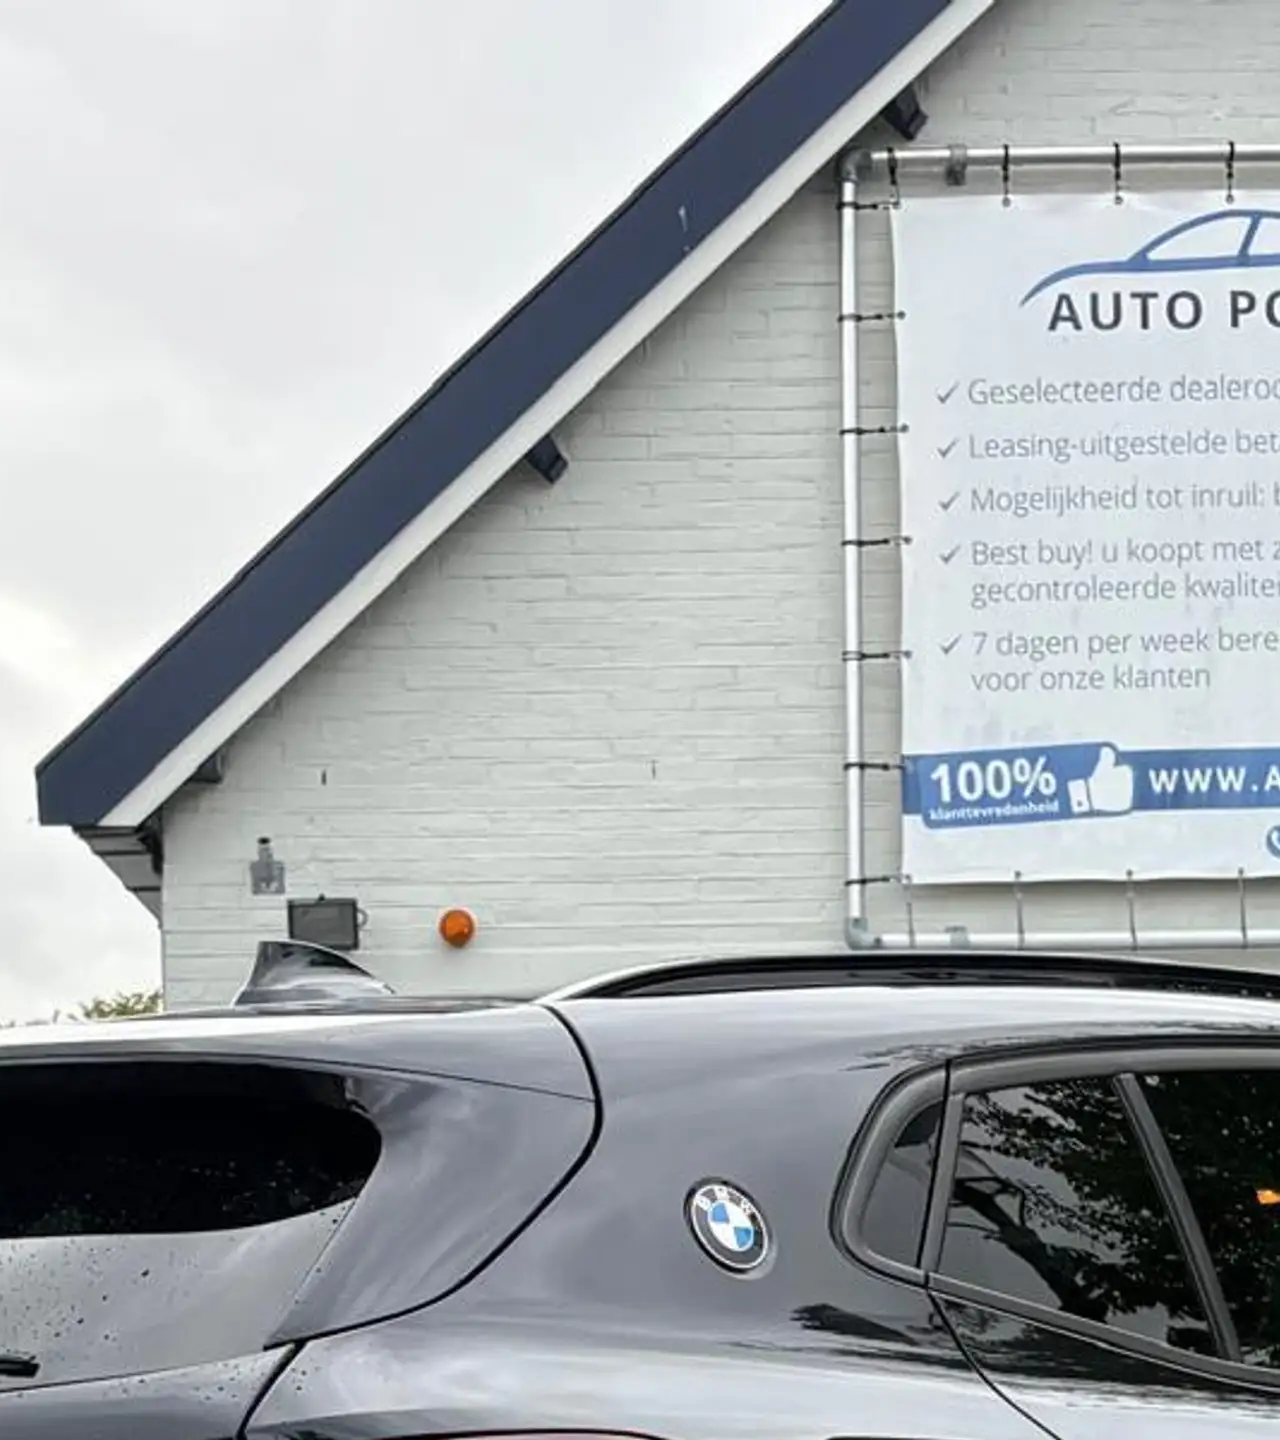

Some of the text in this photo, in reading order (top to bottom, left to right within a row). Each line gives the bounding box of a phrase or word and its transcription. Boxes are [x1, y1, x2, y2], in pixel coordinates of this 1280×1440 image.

[1047, 291, 1202, 331] AUTO
[968, 375, 1161, 405] Geselecteerde
[969, 429, 1227, 464] Leasing-uitgestelde
[970, 481, 1138, 518] Mogelijkheid
[1145, 487, 1182, 509] tot
[1191, 481, 1265, 508] inruil:
[972, 541, 1030, 565] Best
[1037, 539, 1093, 570] buy!
[1102, 546, 1119, 563] u
[1127, 538, 1203, 568] koopt
[1212, 540, 1264, 564] met
[970, 573, 1176, 609] gecontroleerde
[972, 631, 988, 656] 7
[995, 630, 1079, 661] dagen
[1087, 633, 1133, 660] per
[1140, 627, 1211, 652] week
[971, 663, 1211, 692] voor onze klanten
[930, 757, 1057, 804] 100%
